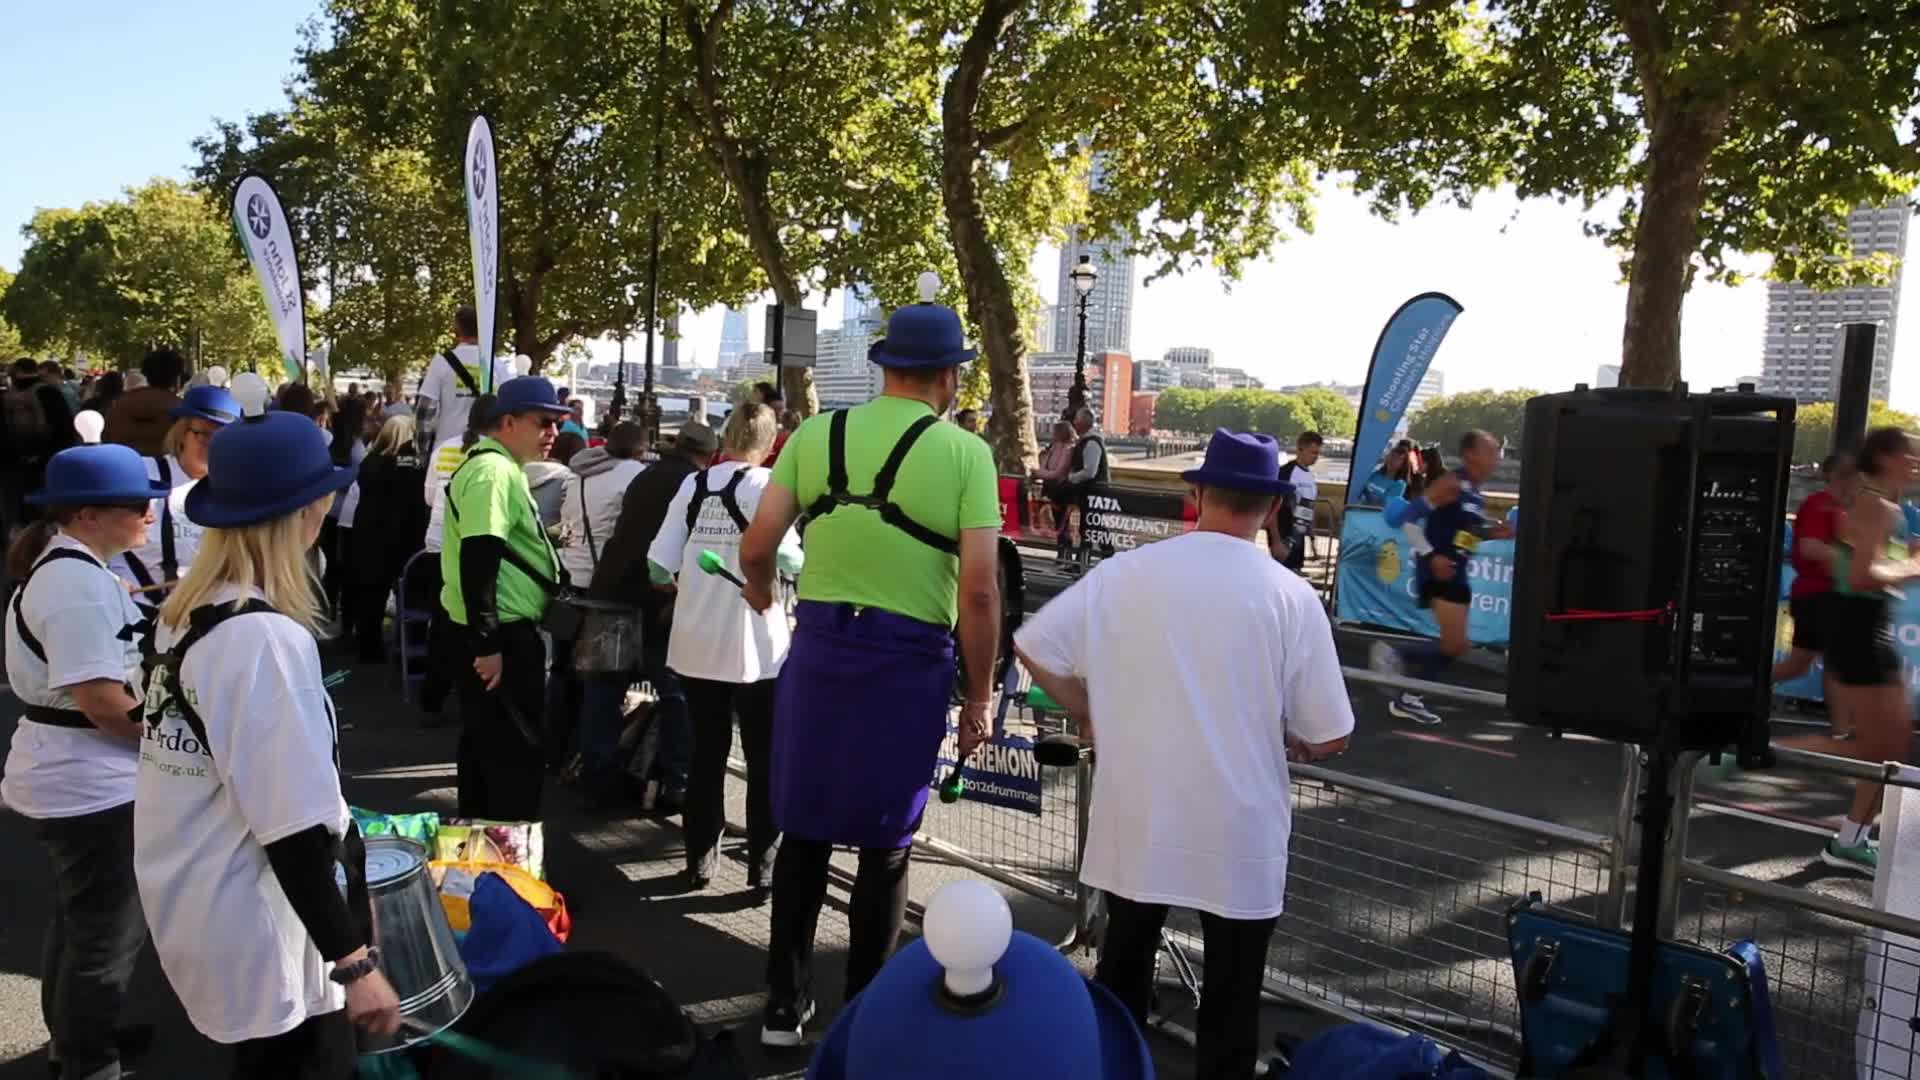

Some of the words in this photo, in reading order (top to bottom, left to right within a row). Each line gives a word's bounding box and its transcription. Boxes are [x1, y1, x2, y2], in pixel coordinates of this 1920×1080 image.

[1380, 354, 1417, 408] Shooting
[1408, 327, 1430, 353] Star
[1087, 495, 1122, 512] TATA
[1085, 511, 1169, 534] CONSULTANCY
[1085, 529, 1137, 548] SERVICES
